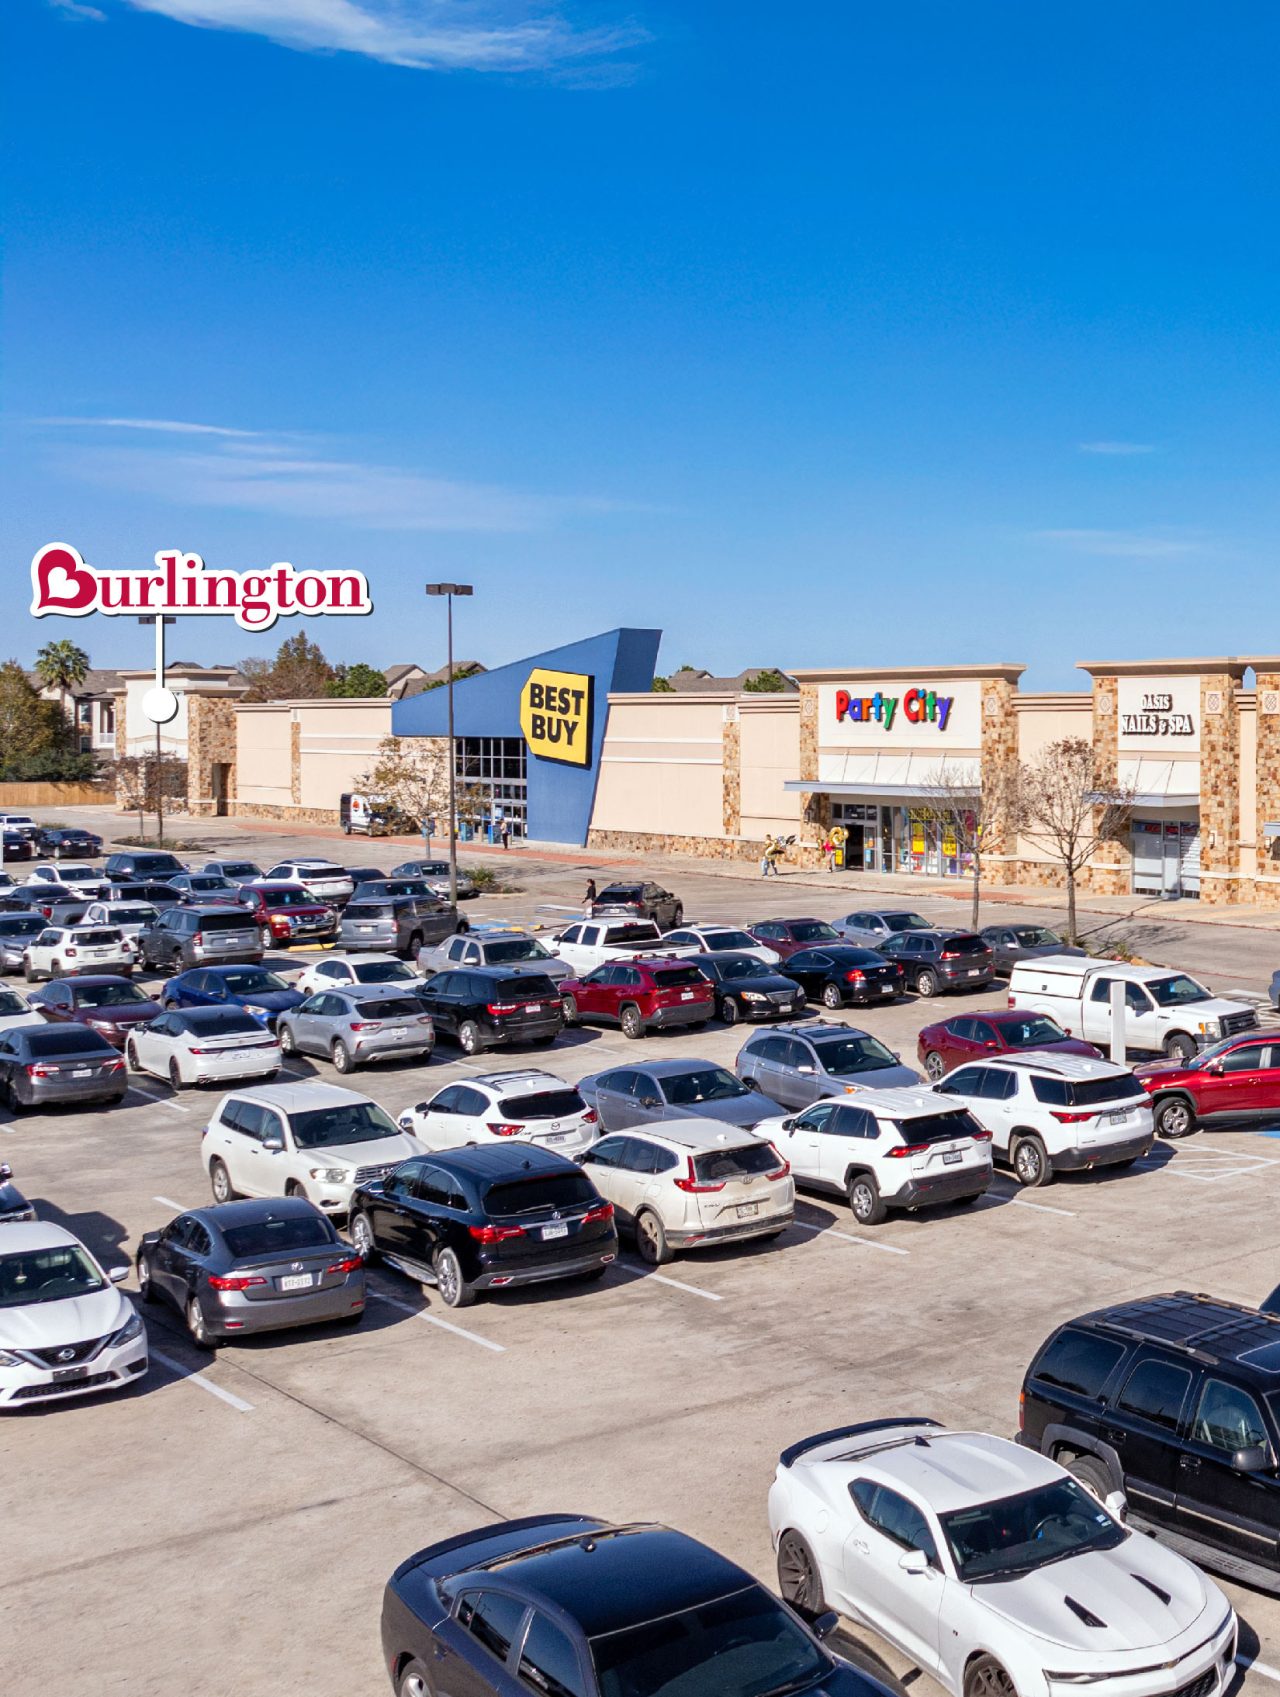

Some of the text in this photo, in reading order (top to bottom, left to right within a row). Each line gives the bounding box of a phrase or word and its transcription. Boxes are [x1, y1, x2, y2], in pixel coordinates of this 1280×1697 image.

[530, 682, 585, 716] BEST
[835, 687, 952, 729] Party City
[1141, 695, 1171, 710] OASIS
[531, 713, 579, 746] BUY
[1121, 715, 1192, 733] NAILS & SPA
